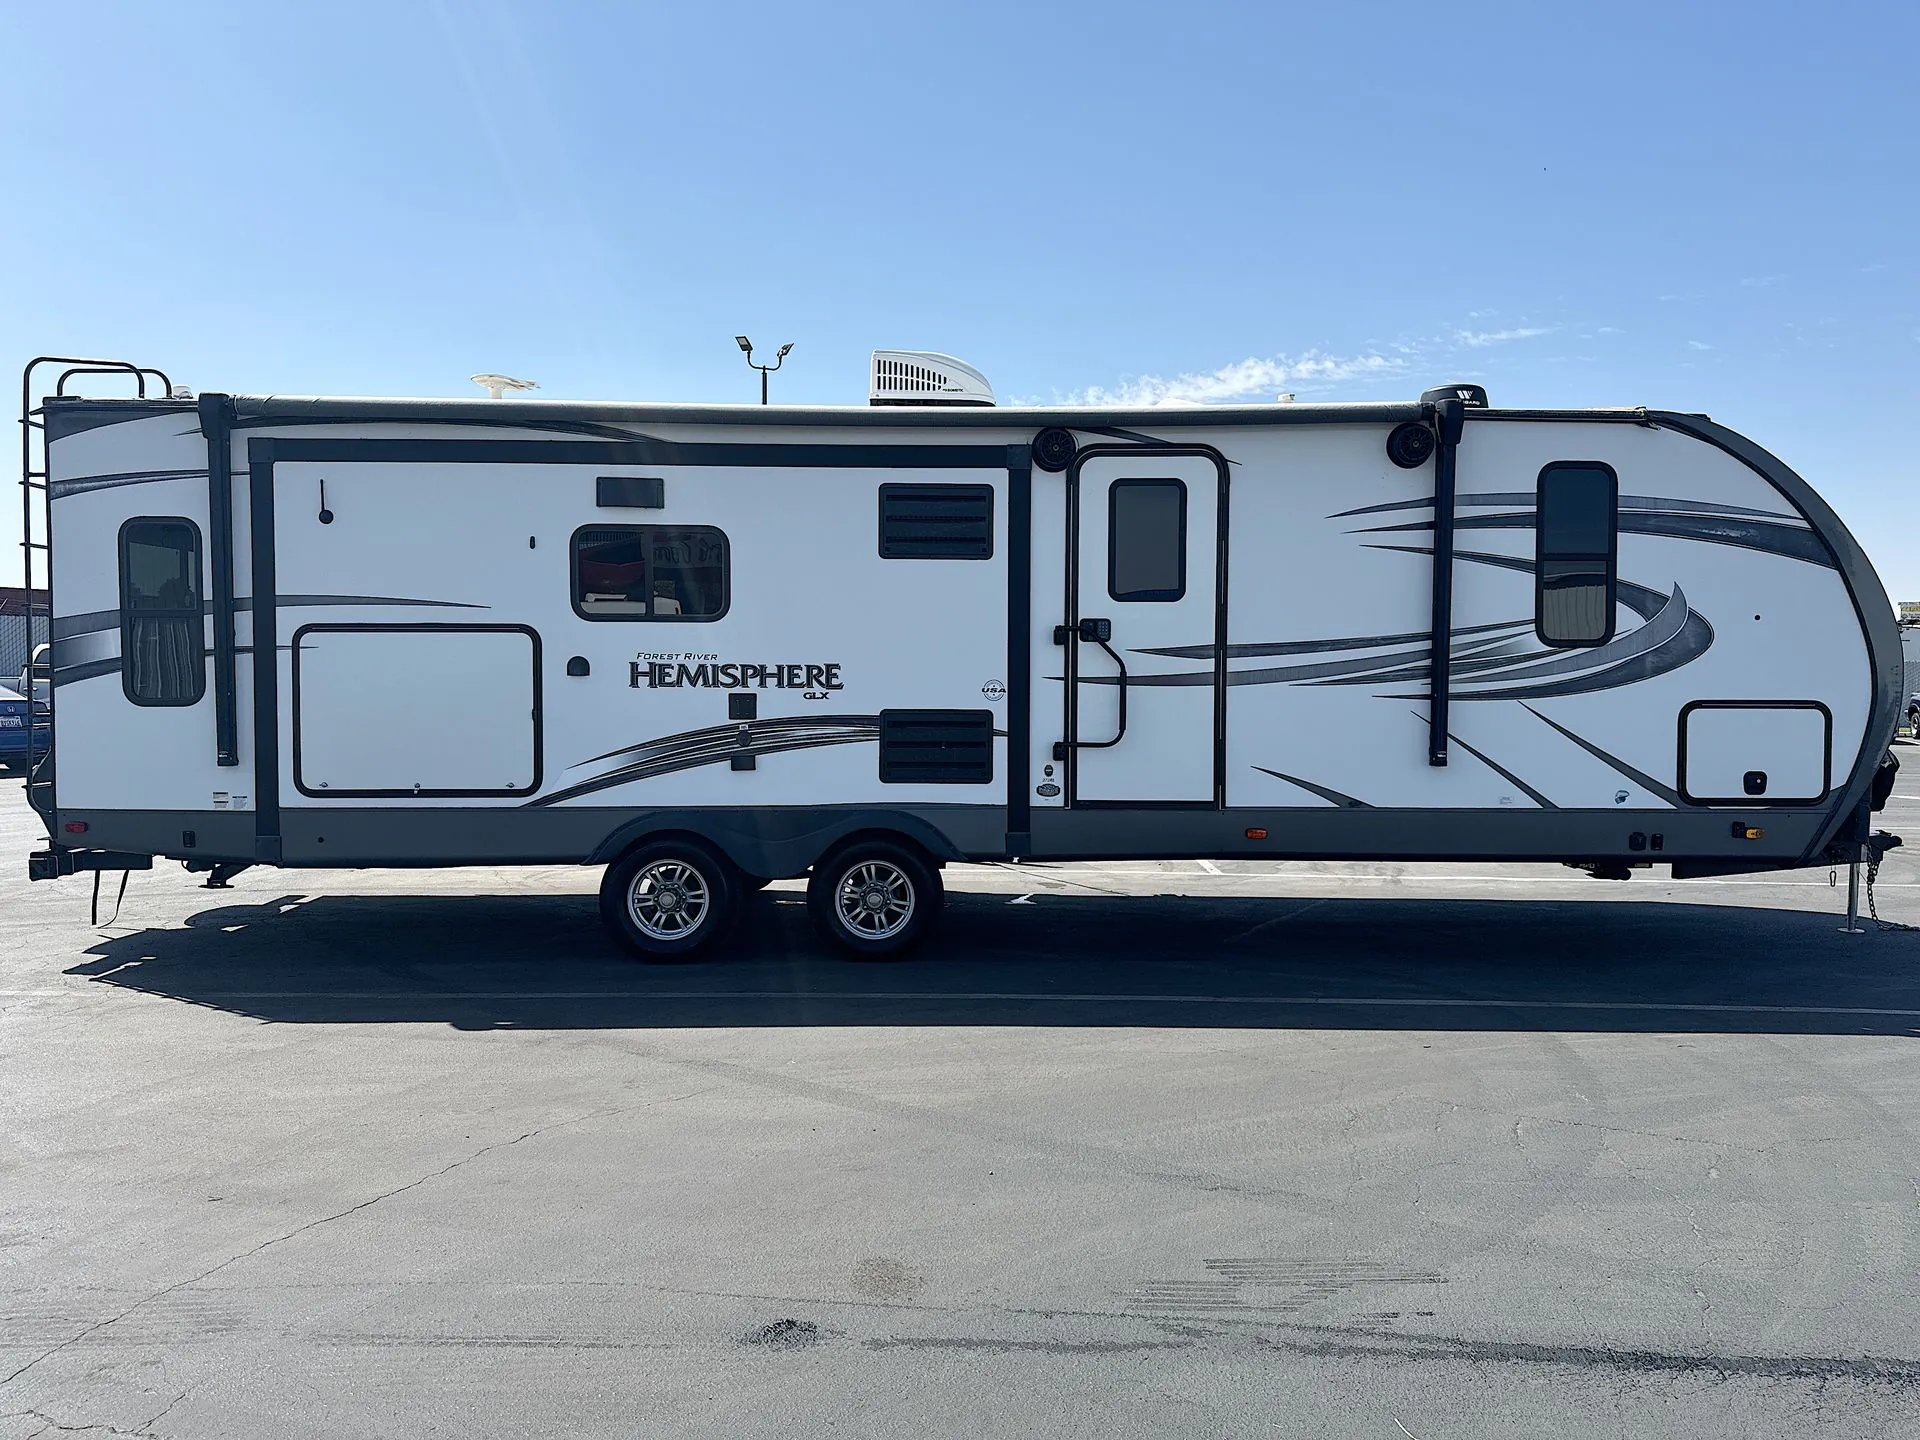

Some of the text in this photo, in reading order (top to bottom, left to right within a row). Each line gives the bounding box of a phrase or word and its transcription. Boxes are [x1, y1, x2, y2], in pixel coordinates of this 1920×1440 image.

[636, 652, 718, 661] FOREST RIVER
[628, 661, 844, 690] HEMISPHERE
[802, 691, 830, 700] GLX
